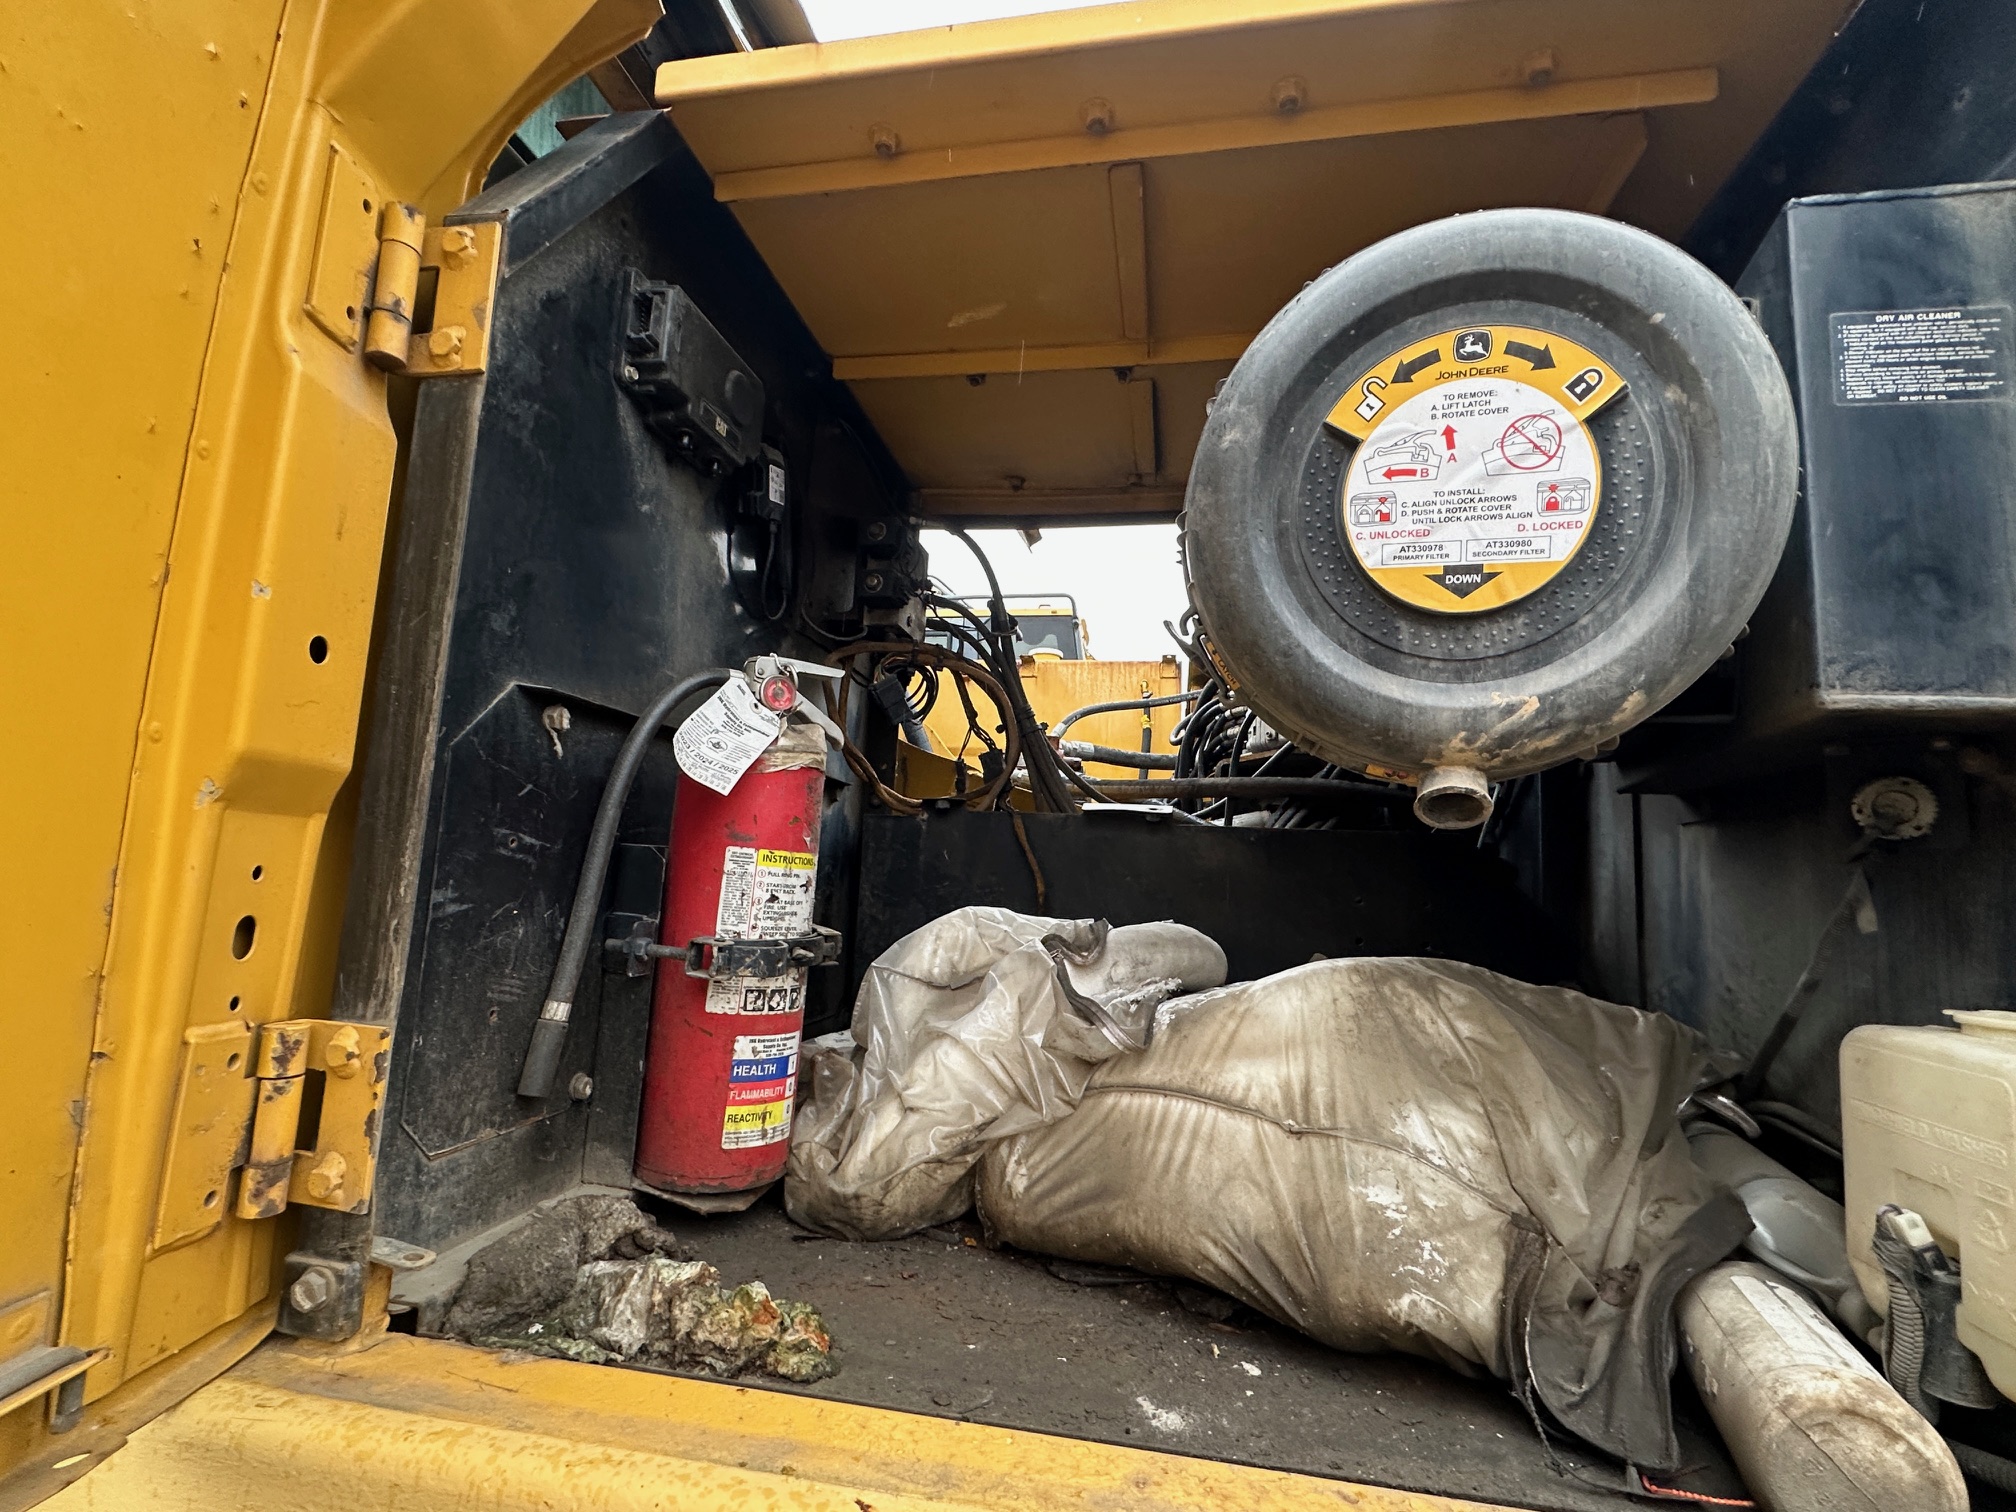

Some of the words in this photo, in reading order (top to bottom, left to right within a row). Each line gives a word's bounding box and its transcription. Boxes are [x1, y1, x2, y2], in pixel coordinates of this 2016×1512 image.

[1875, 314, 1895, 323] DRY
[1898, 313, 1914, 321] AIR
[1916, 311, 1961, 321] CLEANER
[1435, 370, 1468, 381] JOHN
[1469, 365, 1509, 377] DEERE
[1443, 393, 1455, 401] TO
[1457, 389, 1498, 400] REMOVE:
[1441, 402, 1460, 410] LIFT
[1462, 399, 1491, 409] LATCH
[1441, 409, 1476, 419] ROTATE
[1477, 406, 1510, 416] COVER
[1447, 452, 1457, 464] A
[1420, 467, 1430, 478] B
[1433, 490, 1446, 498] TO
[1447, 488, 1486, 497] INSTALL:
[1401, 501, 1410, 509] C.
[1411, 500, 1437, 508] ALIGN
[1439, 497, 1476, 506] UNLOCK
[1477, 494, 1518, 504] ARROWS
[1411, 508, 1435, 516] PUSH
[1445, 505, 1479, 515] ROTATE
[1480, 503, 1512, 512] COVER
[1411, 517, 1437, 525] UNTIL
[1438, 515, 1462, 524] LOCK
[1464, 513, 1504, 522] ARROWS
[1505, 511, 1533, 520] ALIGN
[1517, 523, 1529, 532] D.
[1532, 520, 1584, 531] LOCKED
[1355, 532, 1367, 540] C.
[1369, 528, 1431, 540] UNLOCKED
[1398, 544, 1444, 554] AT330978
[1485, 539, 1533, 549] AT330980
[1392, 553, 1424, 561] PRIMARY
[1472, 549, 1518, 558] SECONDARY
[1519, 548, 1546, 556] FILTER
[1445, 573, 1482, 585] DOWN
[717, 763, 739, 776] 2025
[762, 853, 815, 867] INSTRUCTIONS
[732, 1063, 777, 1077] HEALTH
[729, 1085, 785, 1101] FLAMMABILITY
